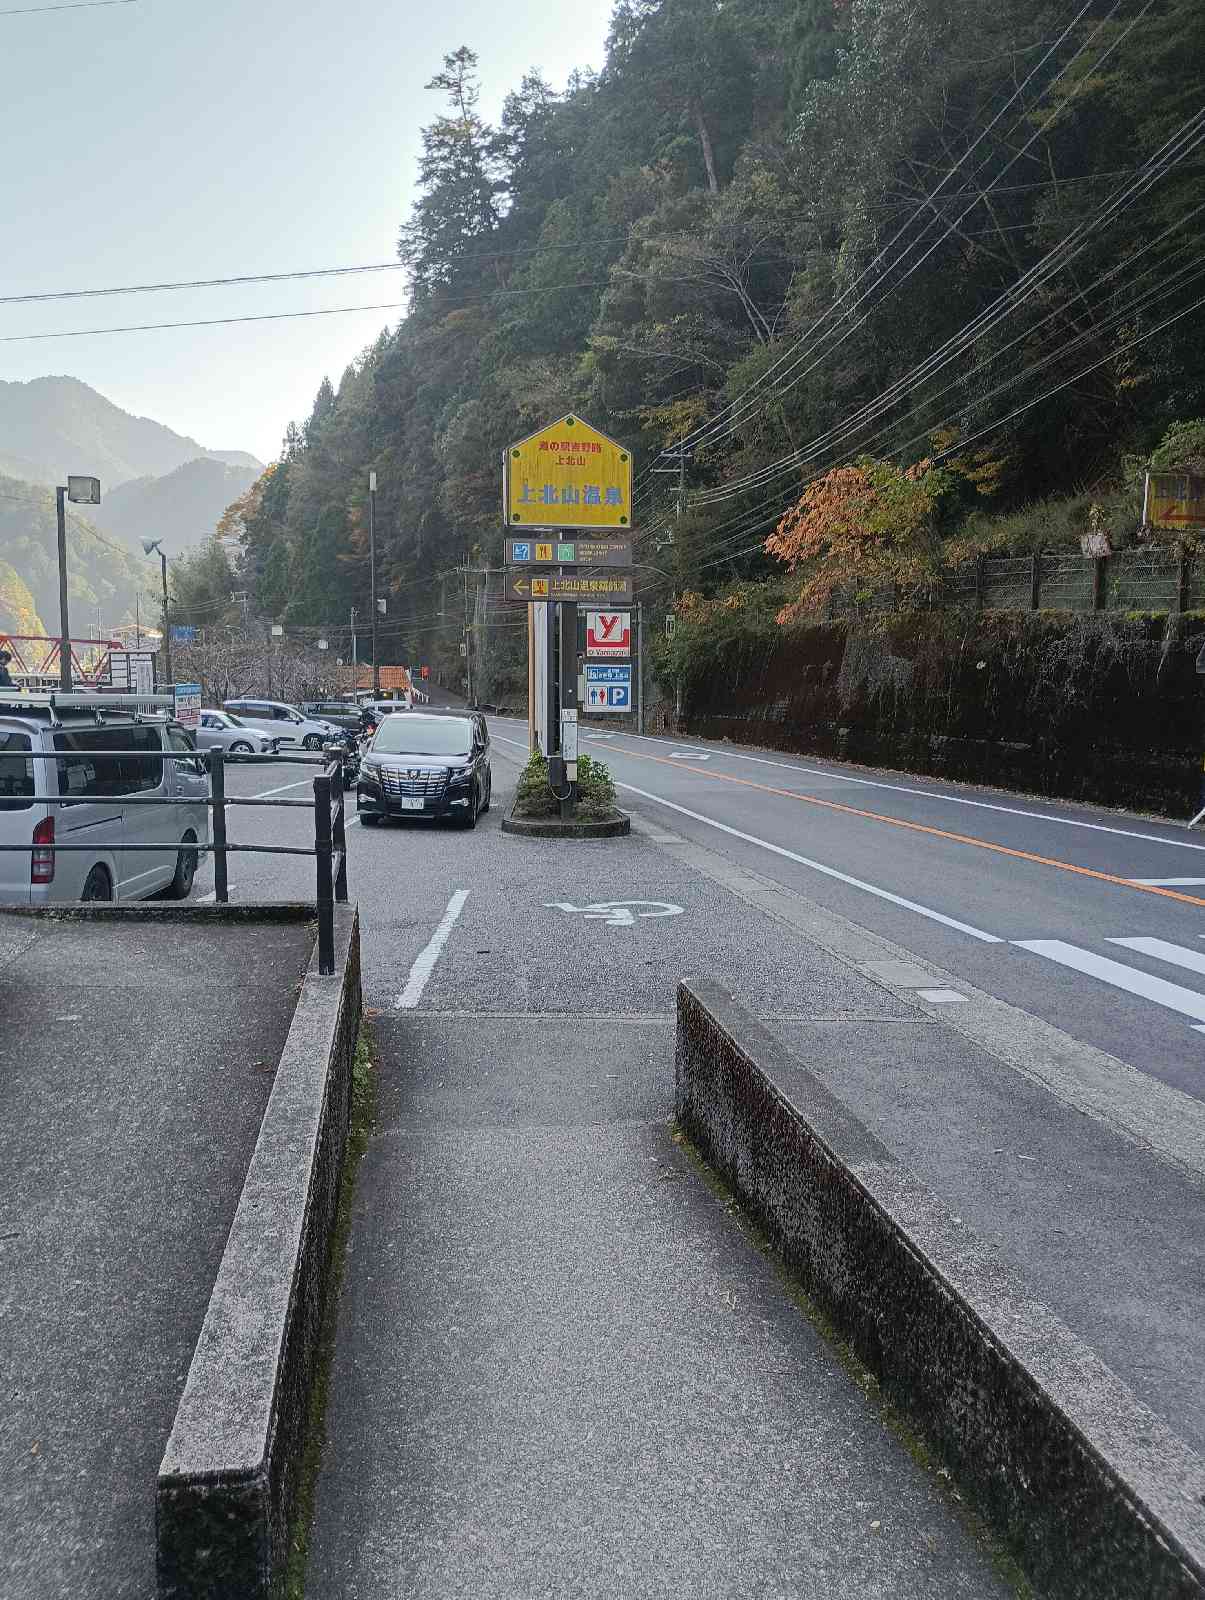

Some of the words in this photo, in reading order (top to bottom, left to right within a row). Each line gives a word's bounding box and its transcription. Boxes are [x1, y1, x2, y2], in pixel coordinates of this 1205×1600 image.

[555, 455, 586, 466] 上北山
[517, 482, 623, 505] 上北山温泉
[613, 687, 625, 704] P
